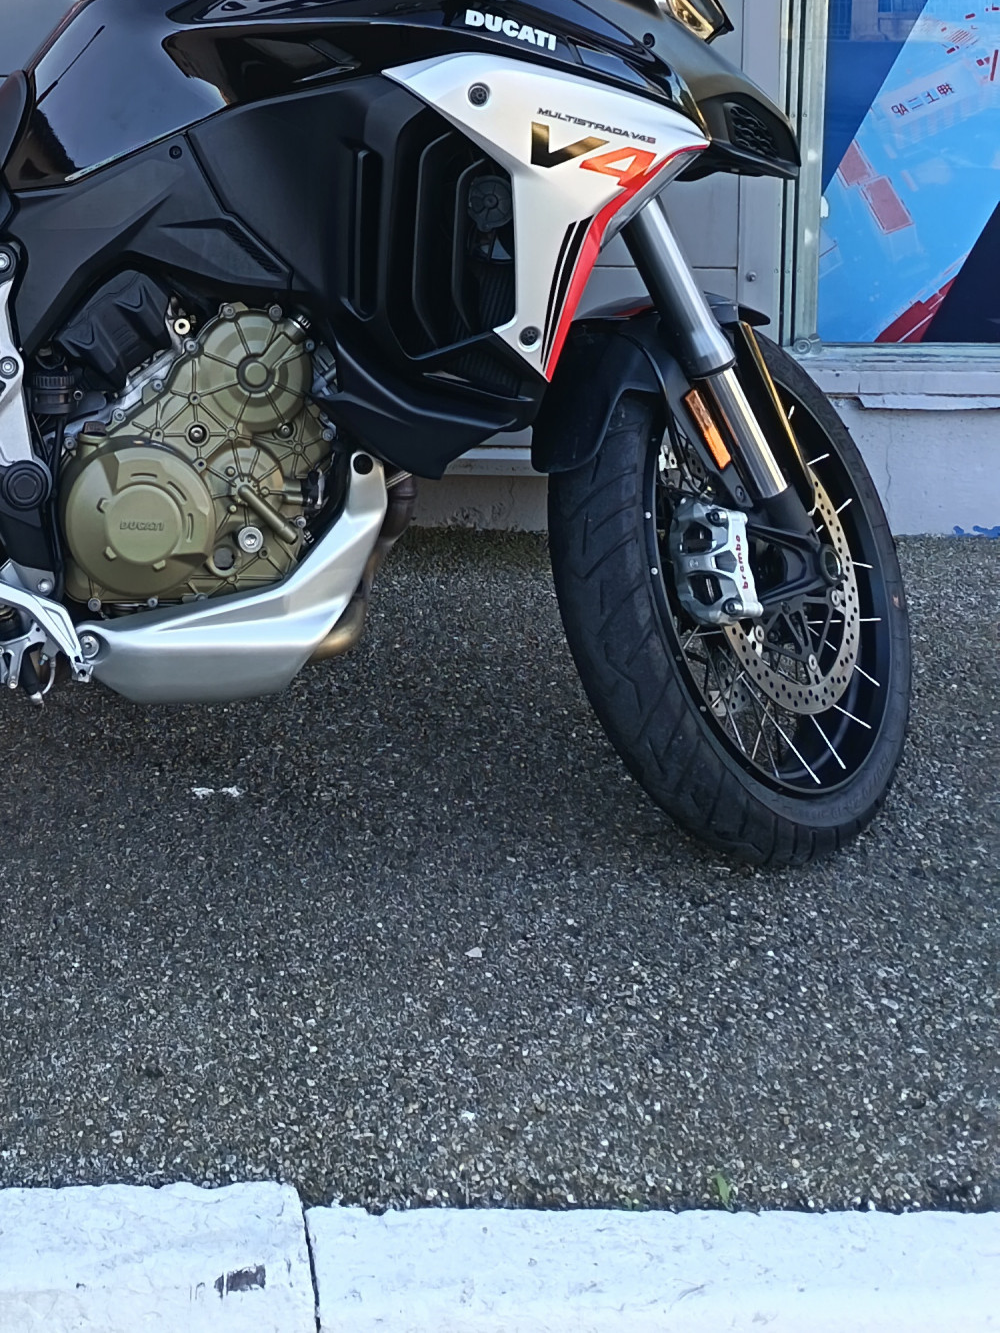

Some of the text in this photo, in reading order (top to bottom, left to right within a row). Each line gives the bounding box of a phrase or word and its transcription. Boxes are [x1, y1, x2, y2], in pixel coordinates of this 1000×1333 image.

[465, 9, 557, 51] DUCATI
[537, 107, 630, 138] MULTISTRADA
[531, 121, 658, 187] V4
[735, 534, 749, 590] brembo
